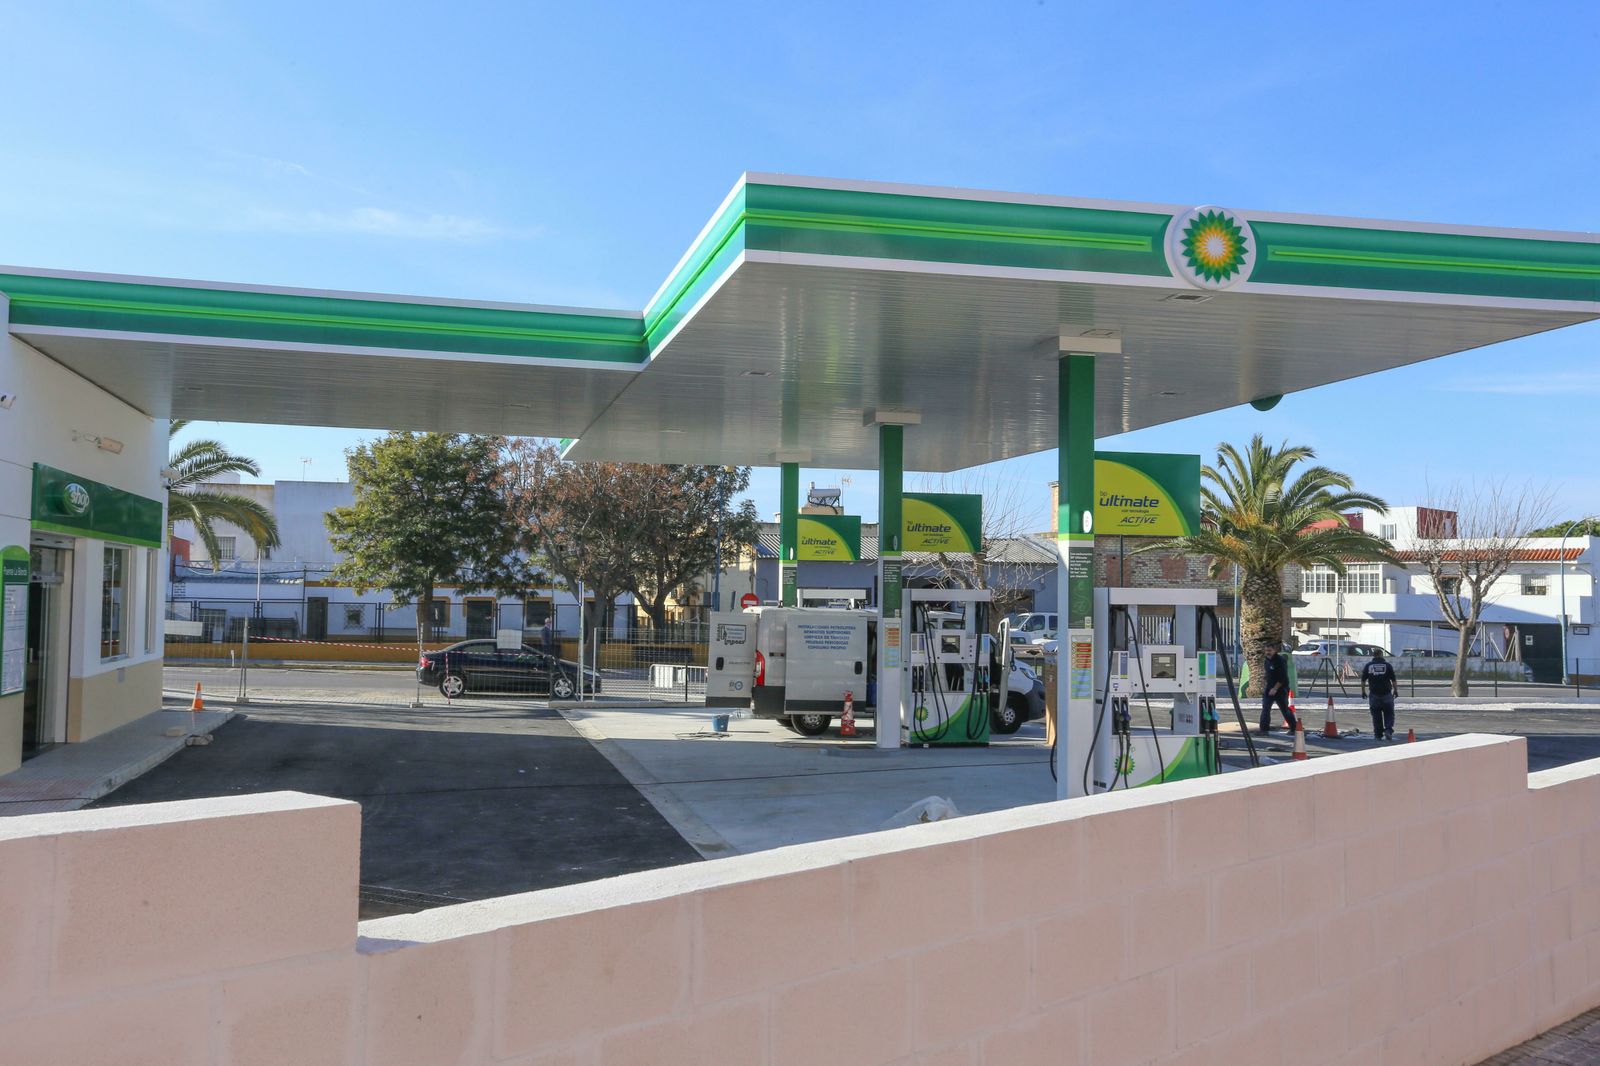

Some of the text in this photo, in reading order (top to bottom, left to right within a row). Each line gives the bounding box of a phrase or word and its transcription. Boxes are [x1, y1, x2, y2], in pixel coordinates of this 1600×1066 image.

[70, 486, 90, 512] shop
[1099, 494, 1159, 508] ultimate
[907, 522, 952, 532] ultimate
[801, 537, 837, 545] ultimate
